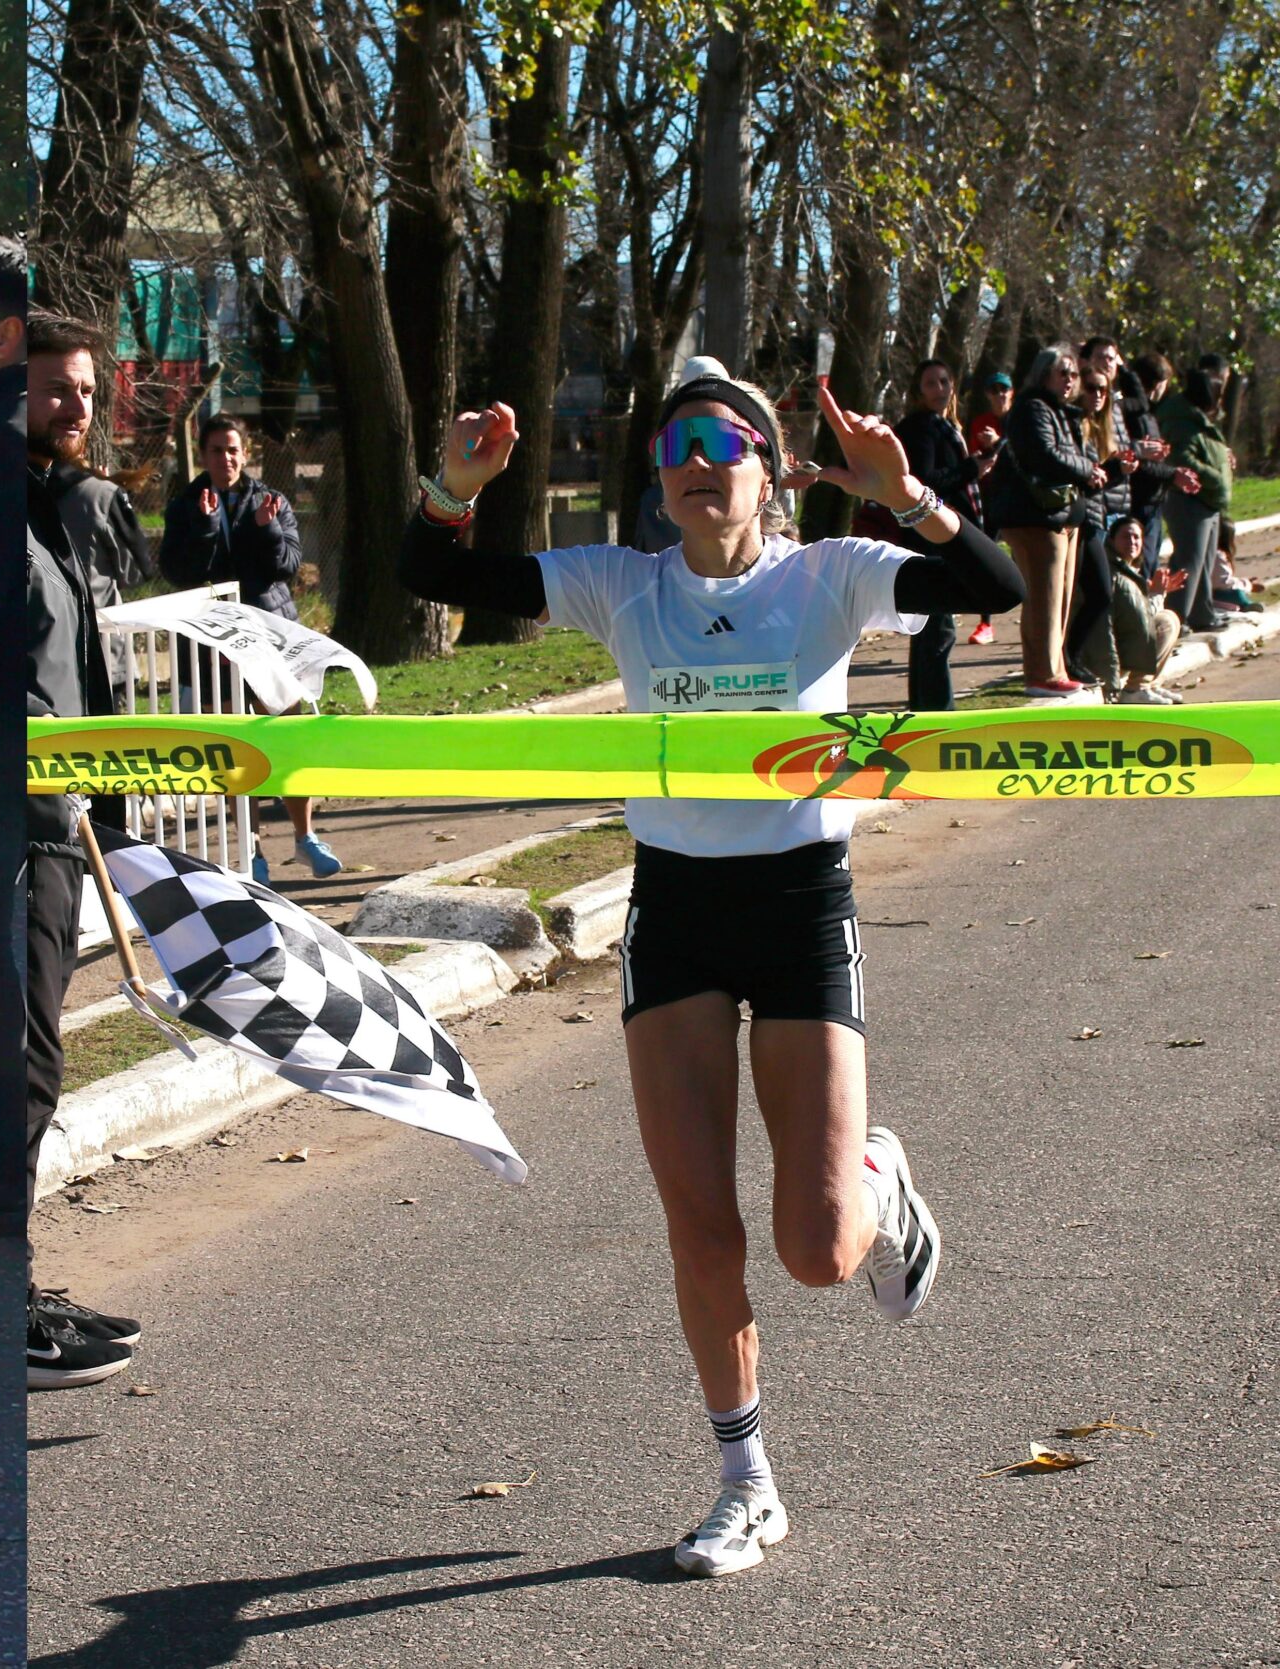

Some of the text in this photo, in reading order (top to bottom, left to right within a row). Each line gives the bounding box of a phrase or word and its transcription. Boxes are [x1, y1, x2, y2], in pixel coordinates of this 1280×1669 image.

[713, 671, 788, 690] RUFF
[713, 688, 788, 698] TRAINING CENTER
[939, 738, 1212, 770] MARATHON
[65, 773, 228, 795] eventos
[997, 768, 1196, 797] eventos
